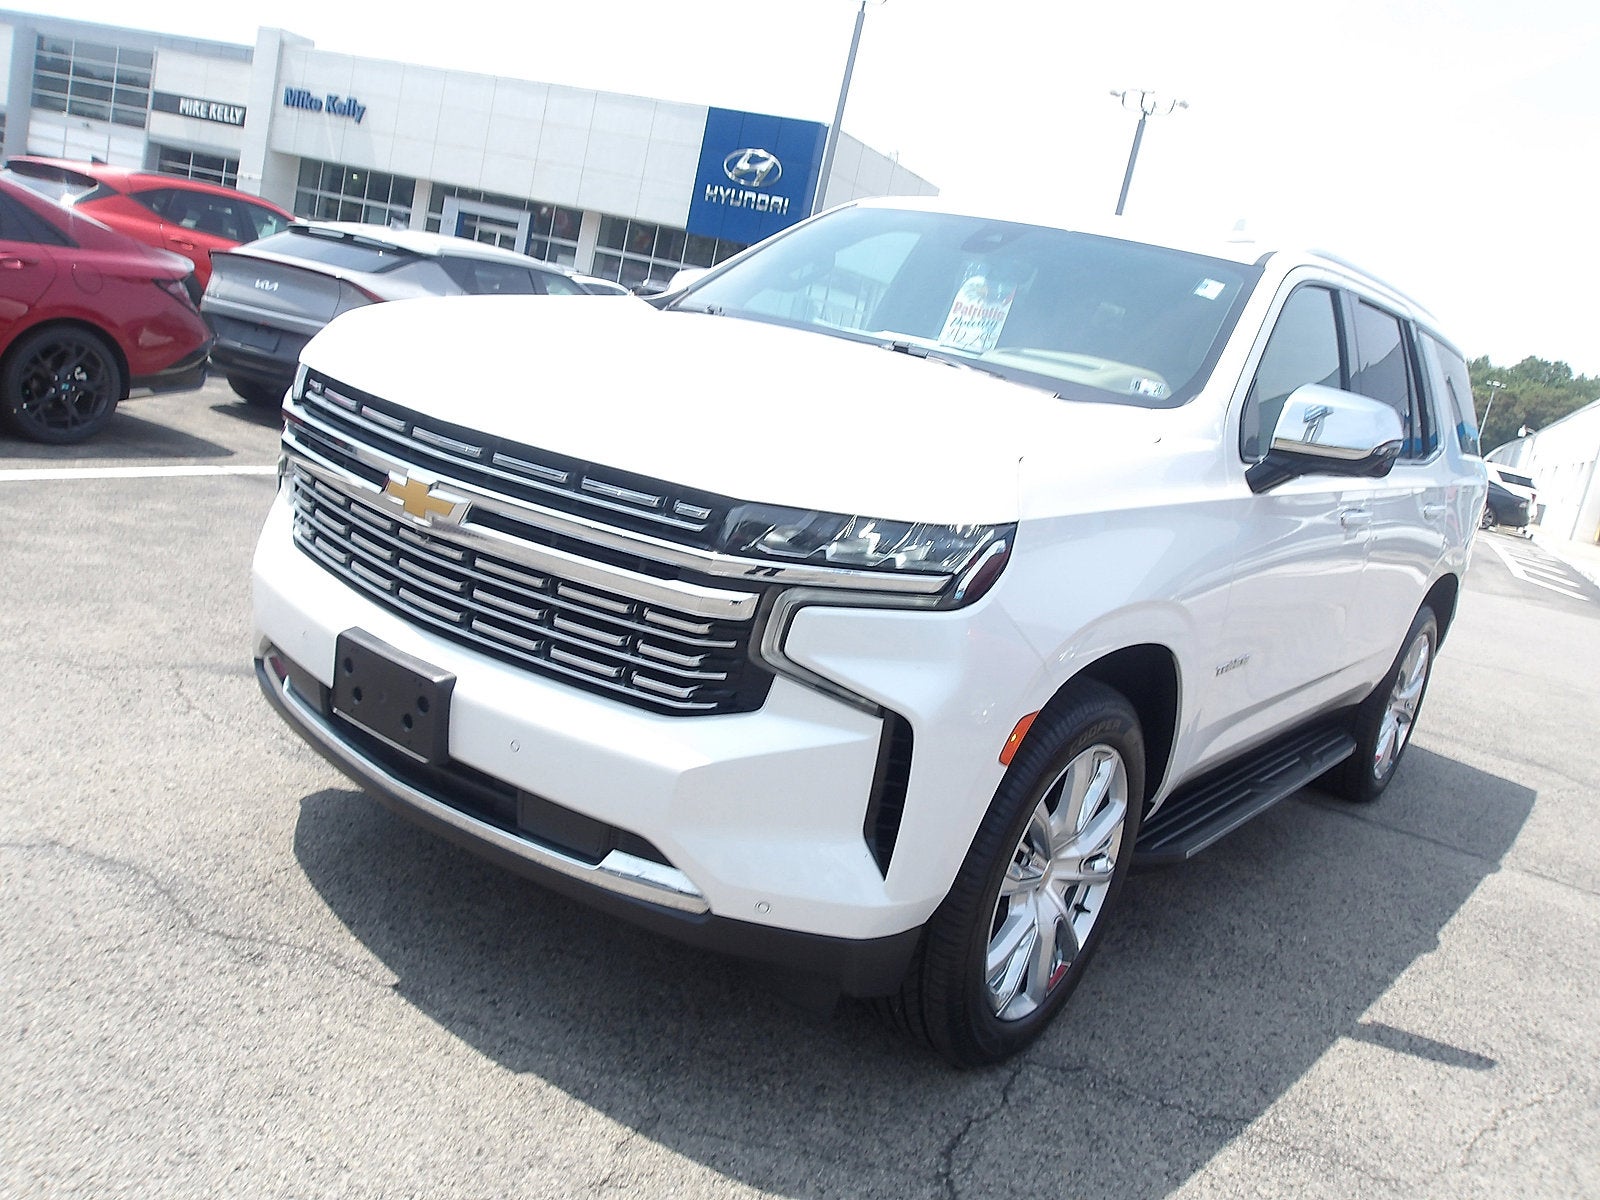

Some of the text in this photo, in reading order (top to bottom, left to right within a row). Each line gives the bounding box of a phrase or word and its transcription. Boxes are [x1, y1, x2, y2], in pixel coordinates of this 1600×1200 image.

[179, 98, 245, 126] MIKE KELLY
[284, 86, 367, 125] Mike Kelly
[704, 183, 790, 216] HYUNDAI
